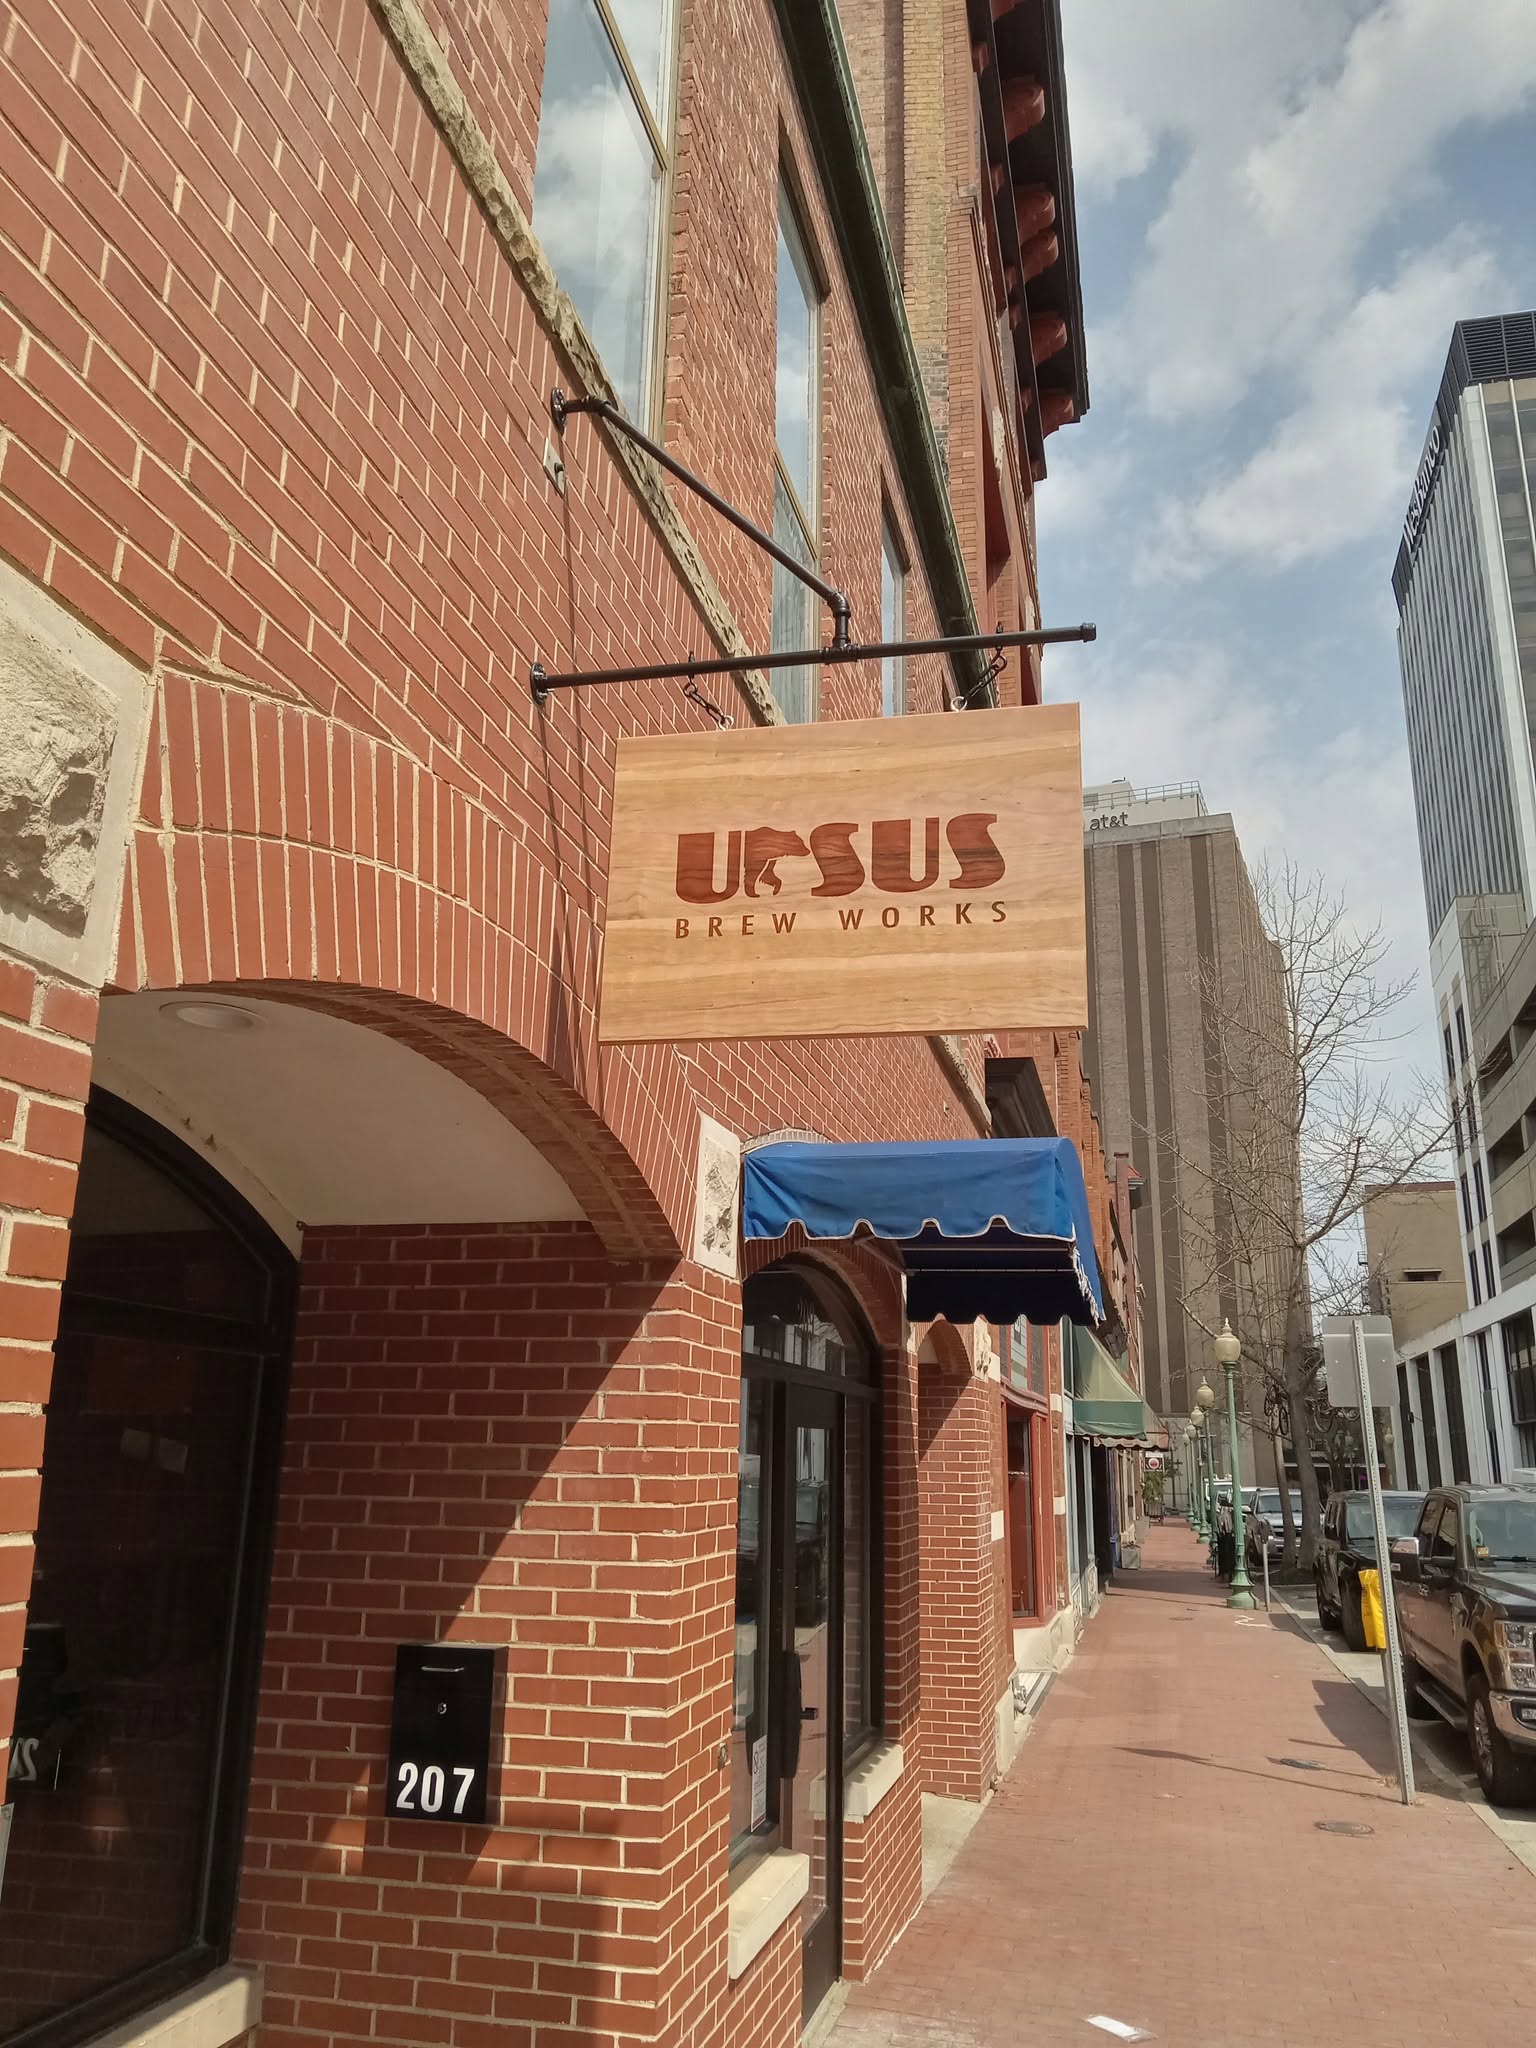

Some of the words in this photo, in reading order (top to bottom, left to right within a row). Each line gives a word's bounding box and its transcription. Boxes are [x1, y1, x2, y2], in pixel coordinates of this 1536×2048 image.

[1090, 812, 1129, 831] at&t
[675, 812, 1006, 904] URSUS
[675, 912, 797, 939] BREW
[838, 901, 1007, 930] WORKS
[396, 1762, 475, 1814] 207
